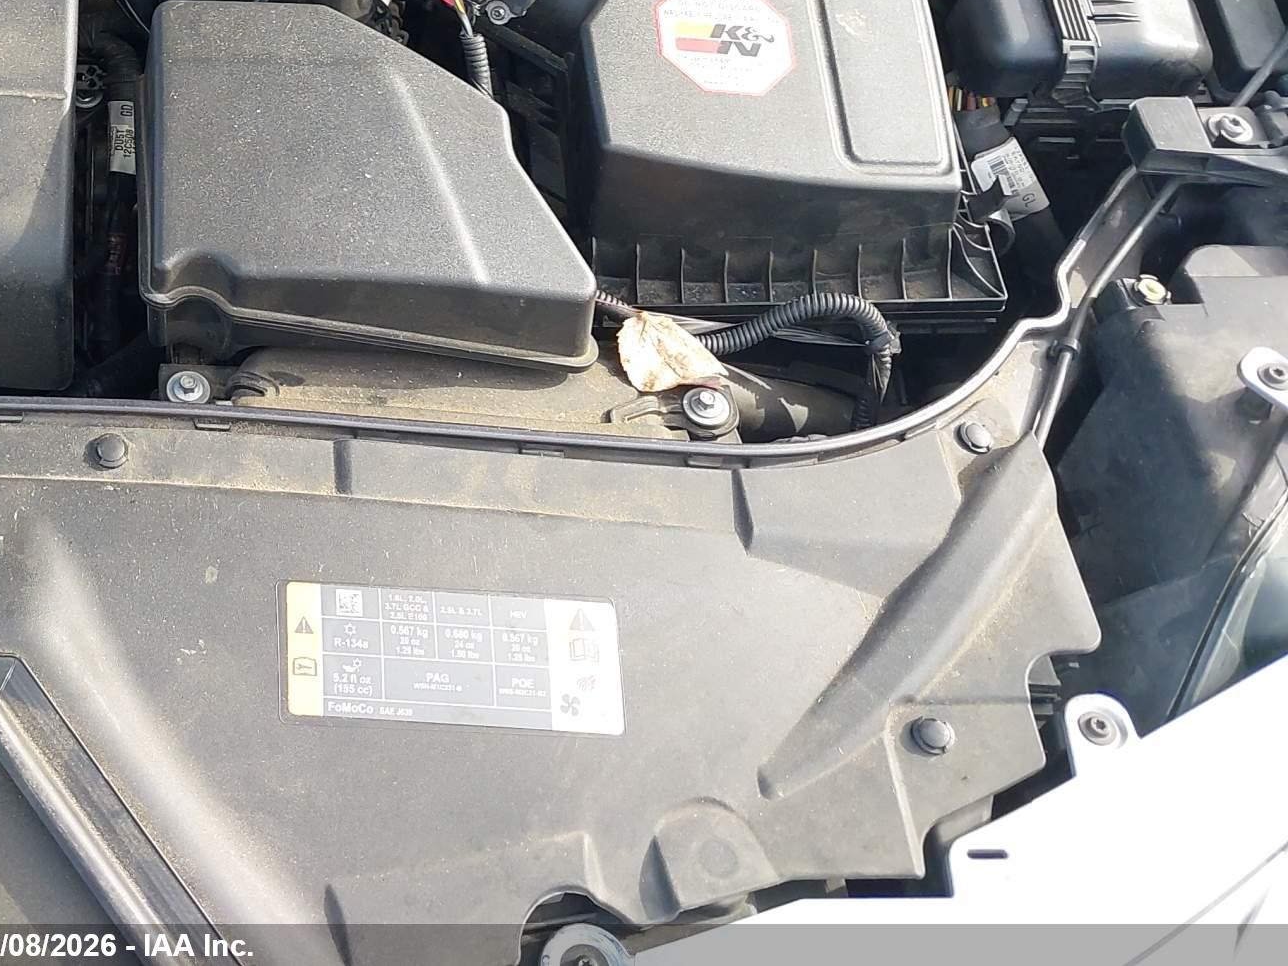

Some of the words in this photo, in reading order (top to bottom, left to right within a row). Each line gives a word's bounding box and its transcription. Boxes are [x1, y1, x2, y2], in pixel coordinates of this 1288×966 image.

[710, 23, 775, 57] K&N
[1022, 192, 1036, 208] GL
[390, 624, 414, 637] 0.567
[416, 626, 429, 639] kg
[333, 637, 369, 649] R-134a
[332, 672, 348, 683] 5.2
[359, 676, 372, 685] oz
[425, 672, 450, 684] PAG
[511, 677, 535, 689] POE
[334, 683, 355, 695] (155
[357, 685, 373, 698] cc)
[327, 701, 374, 715] FoMoCo
